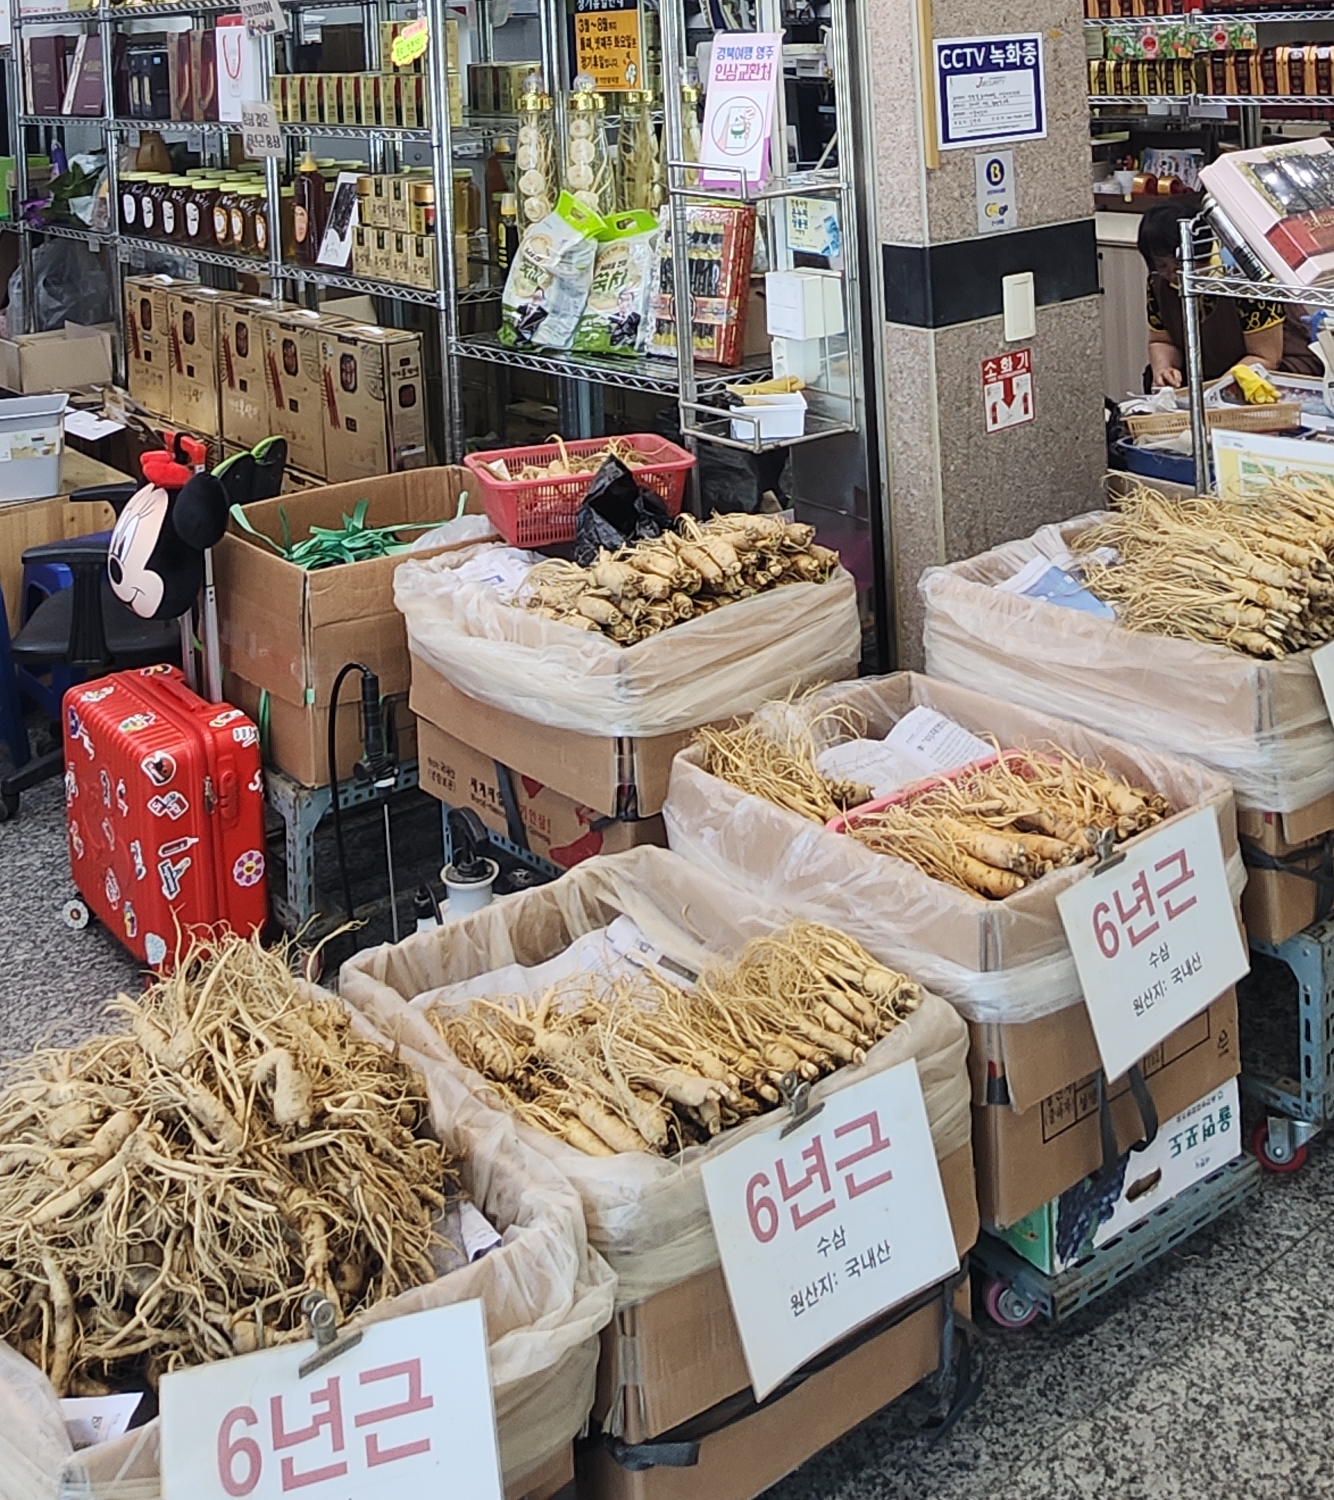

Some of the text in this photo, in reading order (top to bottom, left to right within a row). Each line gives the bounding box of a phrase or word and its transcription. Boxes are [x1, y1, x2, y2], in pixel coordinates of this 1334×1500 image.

[716, 46, 774, 60] 경북여행 영주
[940, 42, 1037, 69] CCTV 녹화중
[714, 63, 772, 81] 인삼교환처
[984, 351, 1029, 379] 소화기
[1092, 848, 1198, 959] 6년근
[1148, 942, 1171, 969] 수삼
[1132, 952, 1203, 1017] 원산지: 국내산
[745, 1110, 893, 1243] 6년근
[816, 1225, 848, 1258] 수삼
[789, 1240, 892, 1318] 원산지: 국내산
[217, 1357, 434, 1497] 6년근
